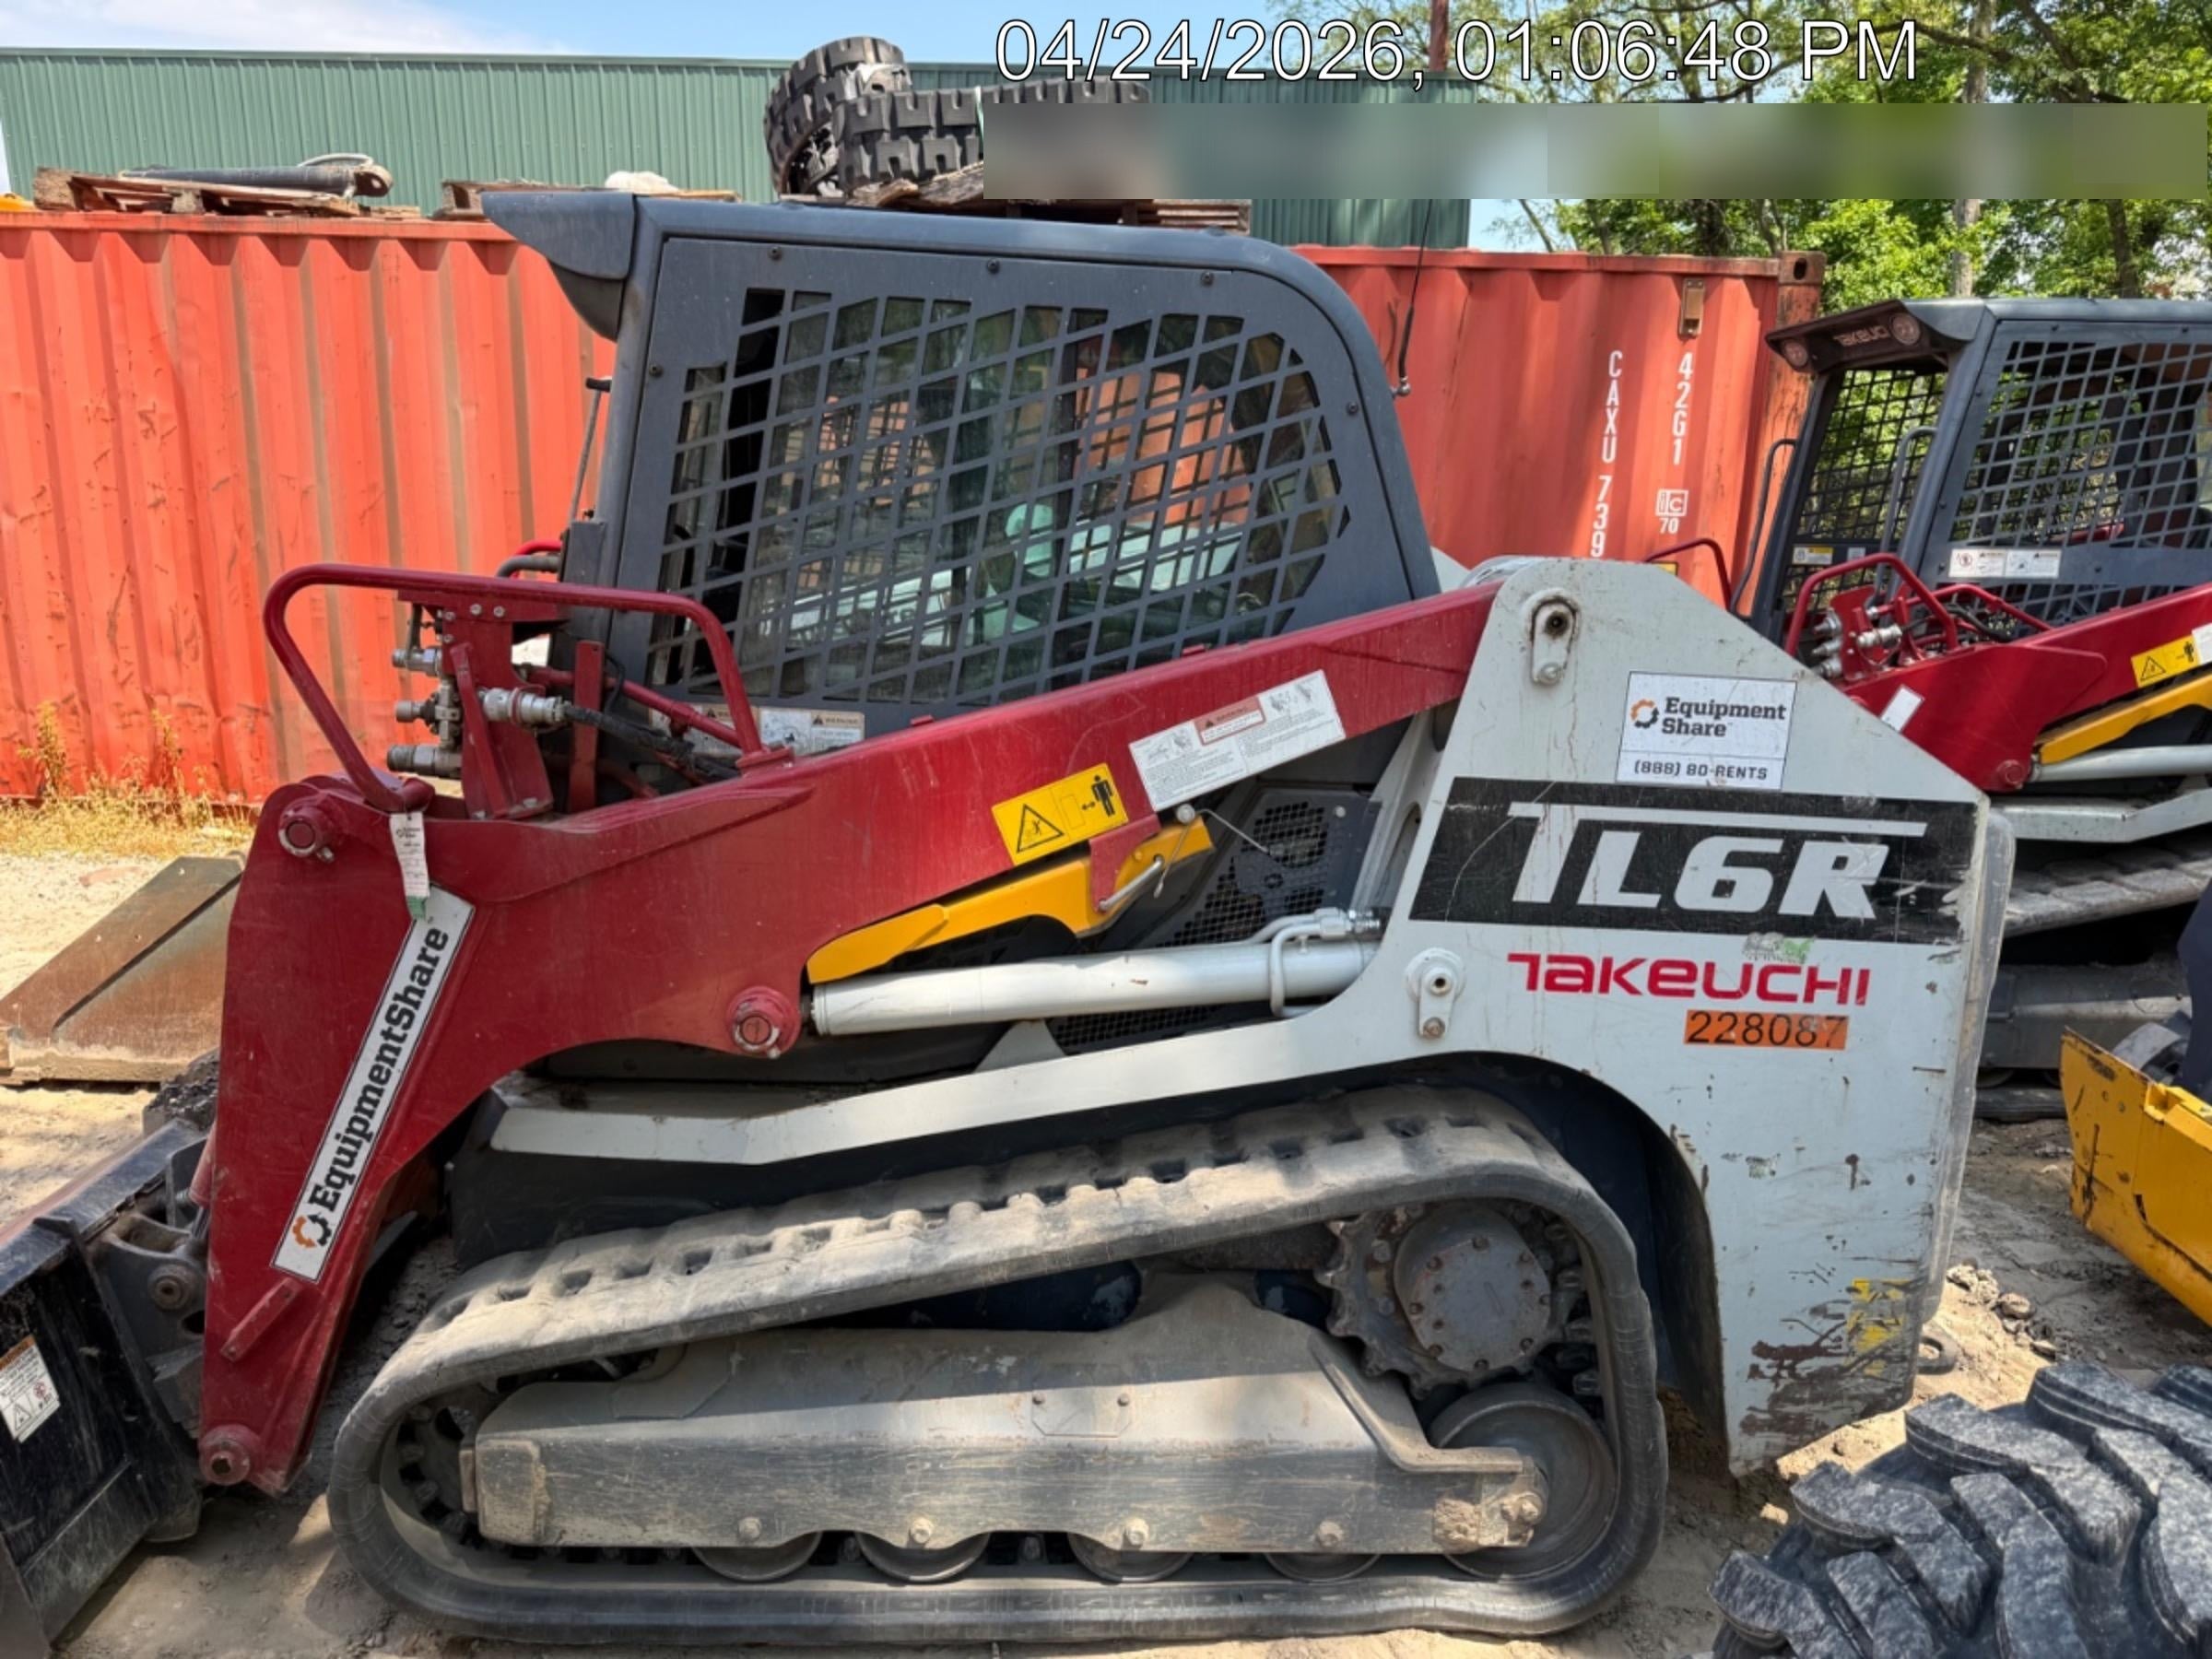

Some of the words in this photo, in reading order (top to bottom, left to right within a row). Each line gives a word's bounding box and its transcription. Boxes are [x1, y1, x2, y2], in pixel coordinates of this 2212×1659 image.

[1602, 350, 1623, 464] CAXU
[1672, 351, 1694, 465] 42G1
[1590, 475, 1612, 558] 739
[1659, 517, 1679, 535] 70
[1662, 717, 1726, 737] Share
[1664, 697, 1786, 721] Equipment
[1634, 759, 1681, 777] (888)
[1686, 763, 1768, 780] 80-RENTS
[1508, 801, 1927, 920] TL6R
[1688, 1012, 1848, 1048] 228087
[307, 925, 450, 1213] EquipmentShare
